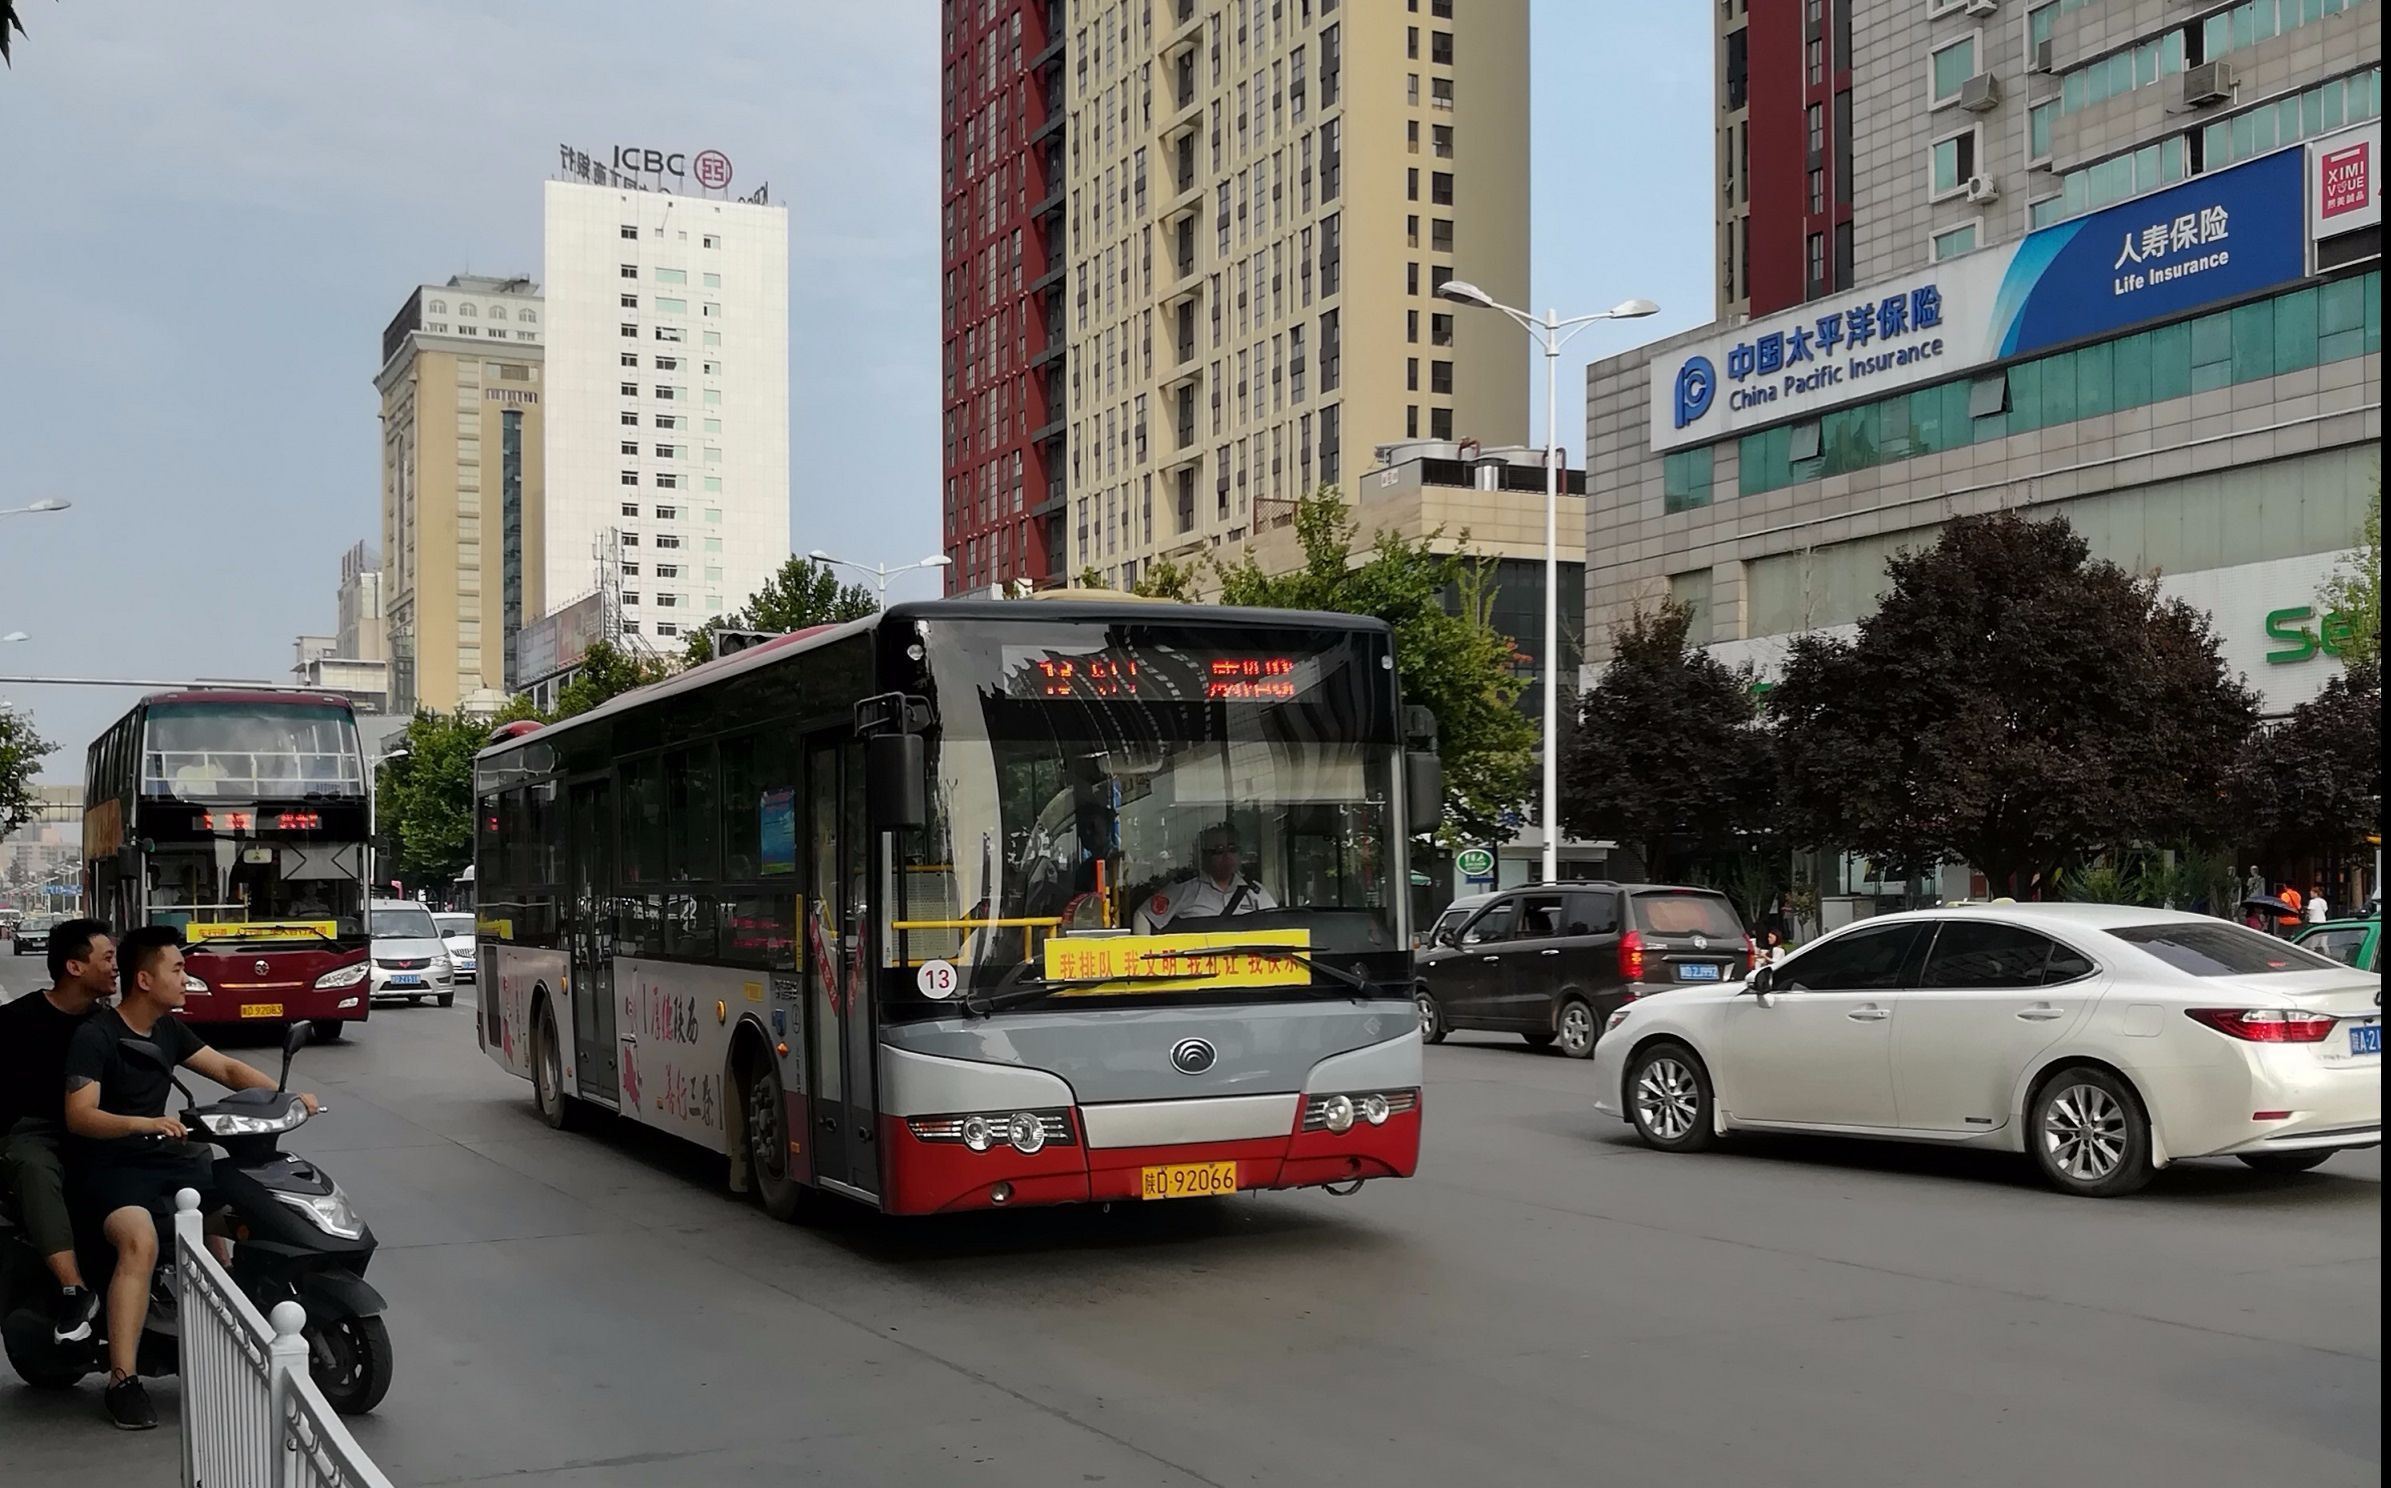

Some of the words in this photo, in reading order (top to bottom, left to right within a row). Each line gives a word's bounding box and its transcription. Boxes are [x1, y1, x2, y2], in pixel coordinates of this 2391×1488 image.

[613, 145, 685, 176] ICBC
[2328, 161, 2364, 184] XIMI
[2114, 204, 2229, 270] 人寿保险
[2114, 273, 2145, 295] Life
[2149, 251, 2229, 286] Insurance
[1727, 284, 1944, 382] 中国太平洋保险
[1729, 384, 1777, 411] China
[1784, 361, 1843, 397] Pacific
[1850, 336, 1944, 380] Insurance
[925, 969, 950, 989] 13
[1060, 951, 1114, 979] 我排队
[1124, 949, 1177, 978] 我文明
